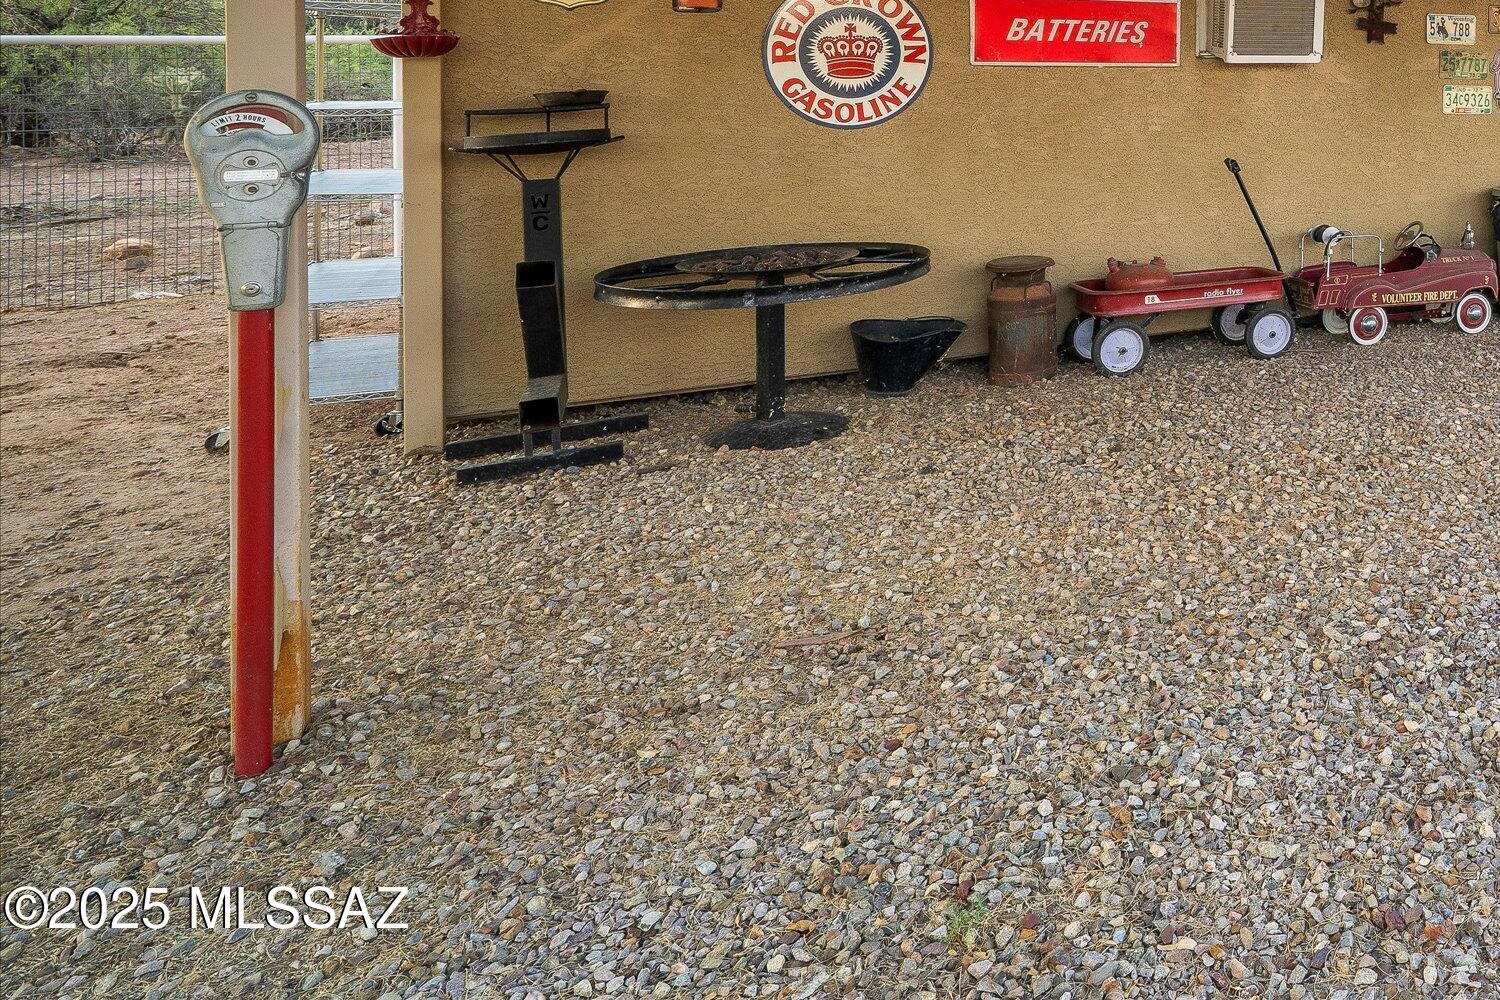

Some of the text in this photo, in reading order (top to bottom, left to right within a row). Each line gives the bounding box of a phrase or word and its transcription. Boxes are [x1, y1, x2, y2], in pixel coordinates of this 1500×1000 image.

[1447, 15, 1474, 24] Wyoming
[772, 0, 815, 65] RED
[1006, 17, 1149, 44] BATTERIES
[1430, 22, 1470, 37] 5 788
[782, 74, 918, 124] GASOLINE
[211, 115, 232, 127] LIMIT
[243, 115, 267, 123] HOURS
[1441, 255, 1462, 264] TRUCK
[1203, 287, 1244, 298] radio flyer
[1382, 290, 1459, 303] VOLUNTEER FIRE DEPT.
